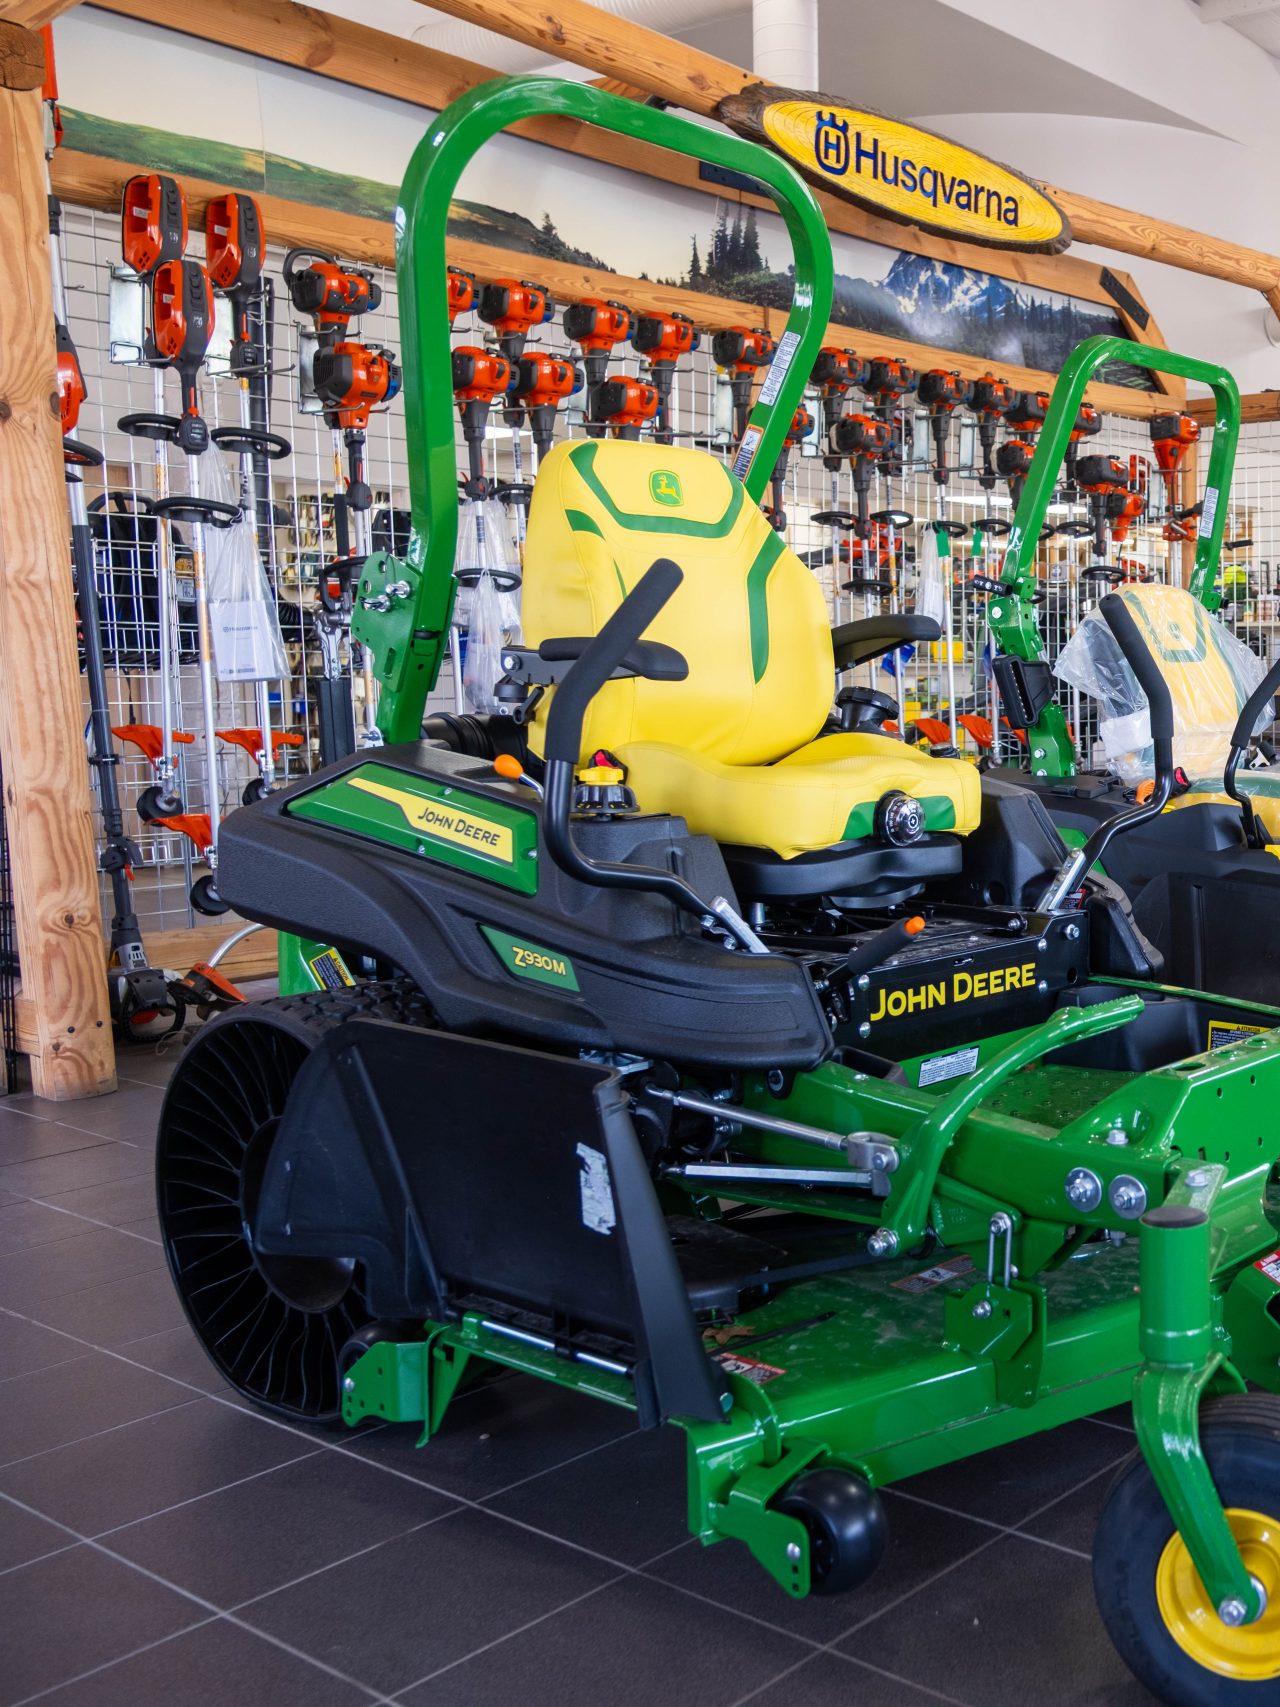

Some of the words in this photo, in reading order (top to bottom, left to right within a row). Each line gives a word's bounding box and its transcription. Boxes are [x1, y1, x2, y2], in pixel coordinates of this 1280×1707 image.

[854, 132, 1020, 228] Husqvarna
[417, 807, 455, 833] JOHN
[454, 818, 501, 847] DEERE
[512, 946, 567, 976] Z930M
[870, 981, 946, 1022] JOHN
[953, 962, 1036, 1003] DEERE
